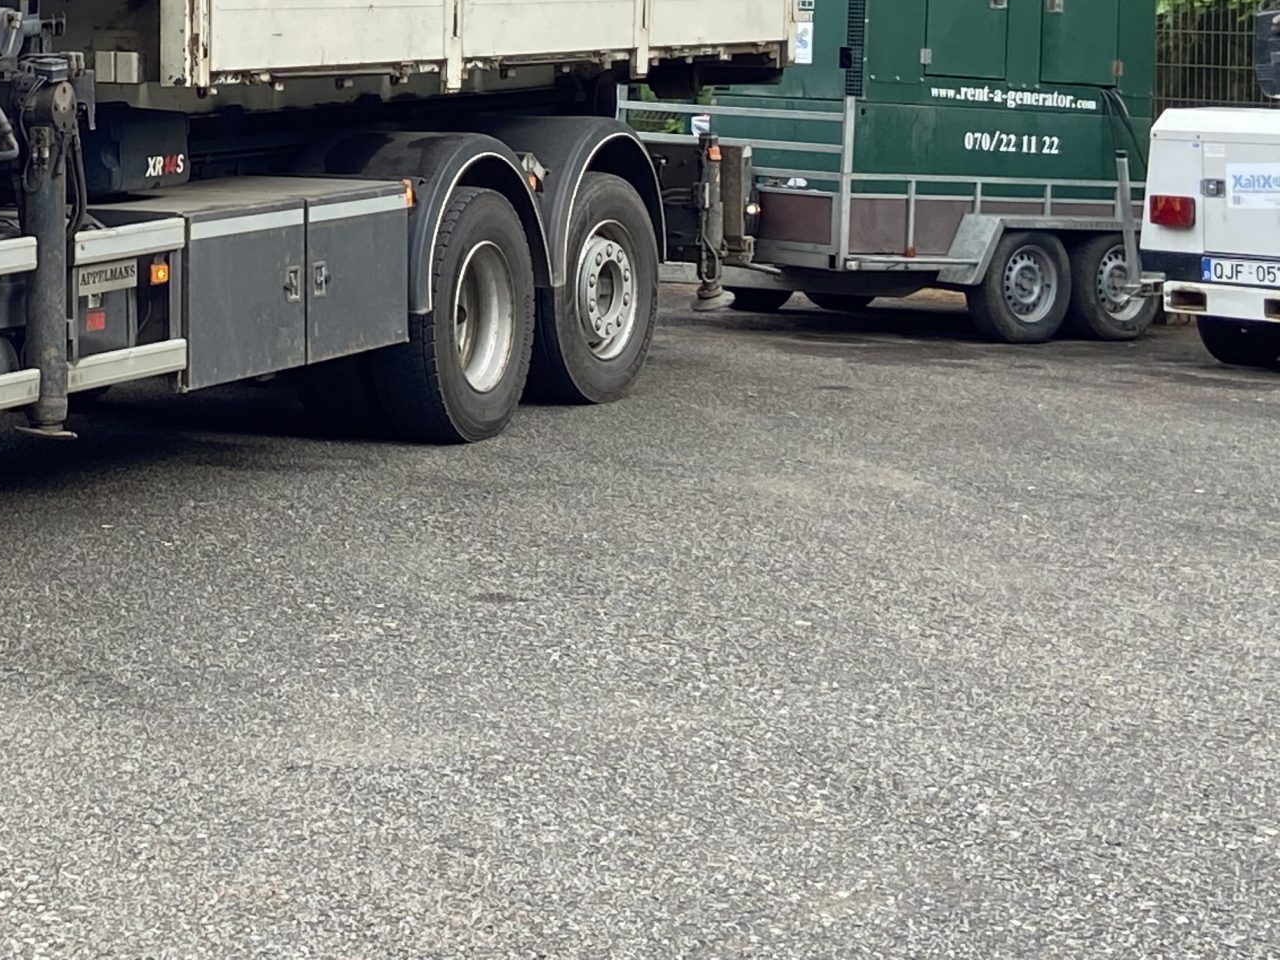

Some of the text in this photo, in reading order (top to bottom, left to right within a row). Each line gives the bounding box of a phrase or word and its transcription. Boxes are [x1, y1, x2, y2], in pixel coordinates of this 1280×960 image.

[930, 85, 1097, 110] www.rent-a-generator.com
[964, 130, 1060, 154] 070/22 11 22
[1232, 174, 1273, 190] XaliX
[80, 264, 136, 286] APPELMANS
[1213, 262, 1280, 283] QJF-05
